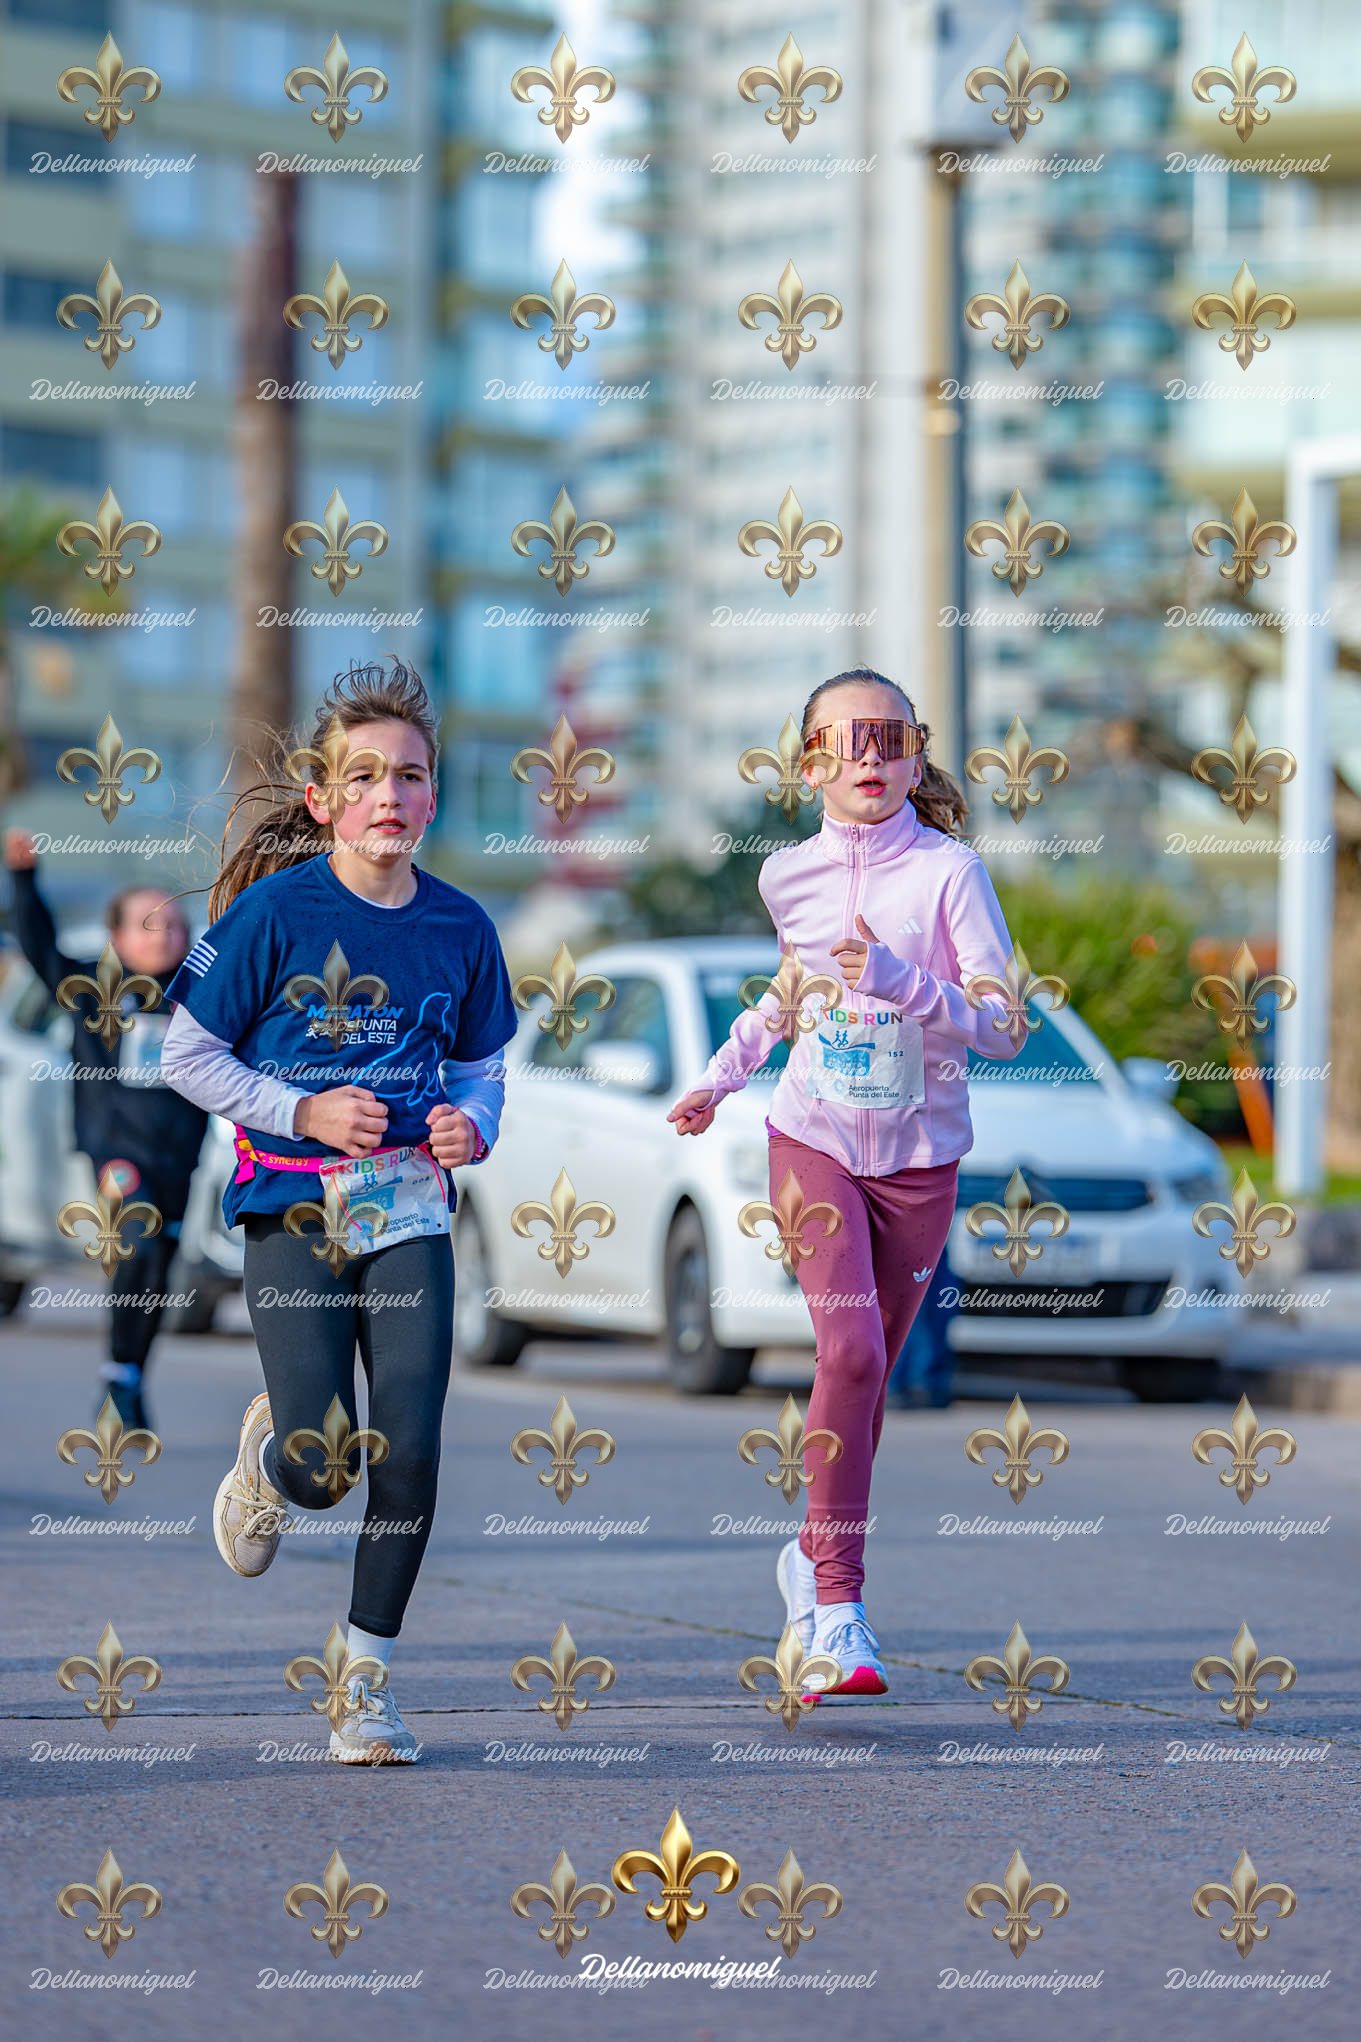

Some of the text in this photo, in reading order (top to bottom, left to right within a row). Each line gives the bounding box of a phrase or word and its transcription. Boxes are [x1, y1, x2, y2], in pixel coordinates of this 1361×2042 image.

[864, 1012, 903, 1025] RUN
[356, 1019, 397, 1031] PUNTA
[340, 1032, 396, 1045] DEL ESTE
[849, 1085, 889, 1093] Aeropuerto
[269, 1156, 309, 1167] synergy
[340, 1158, 385, 1174] KIDS
